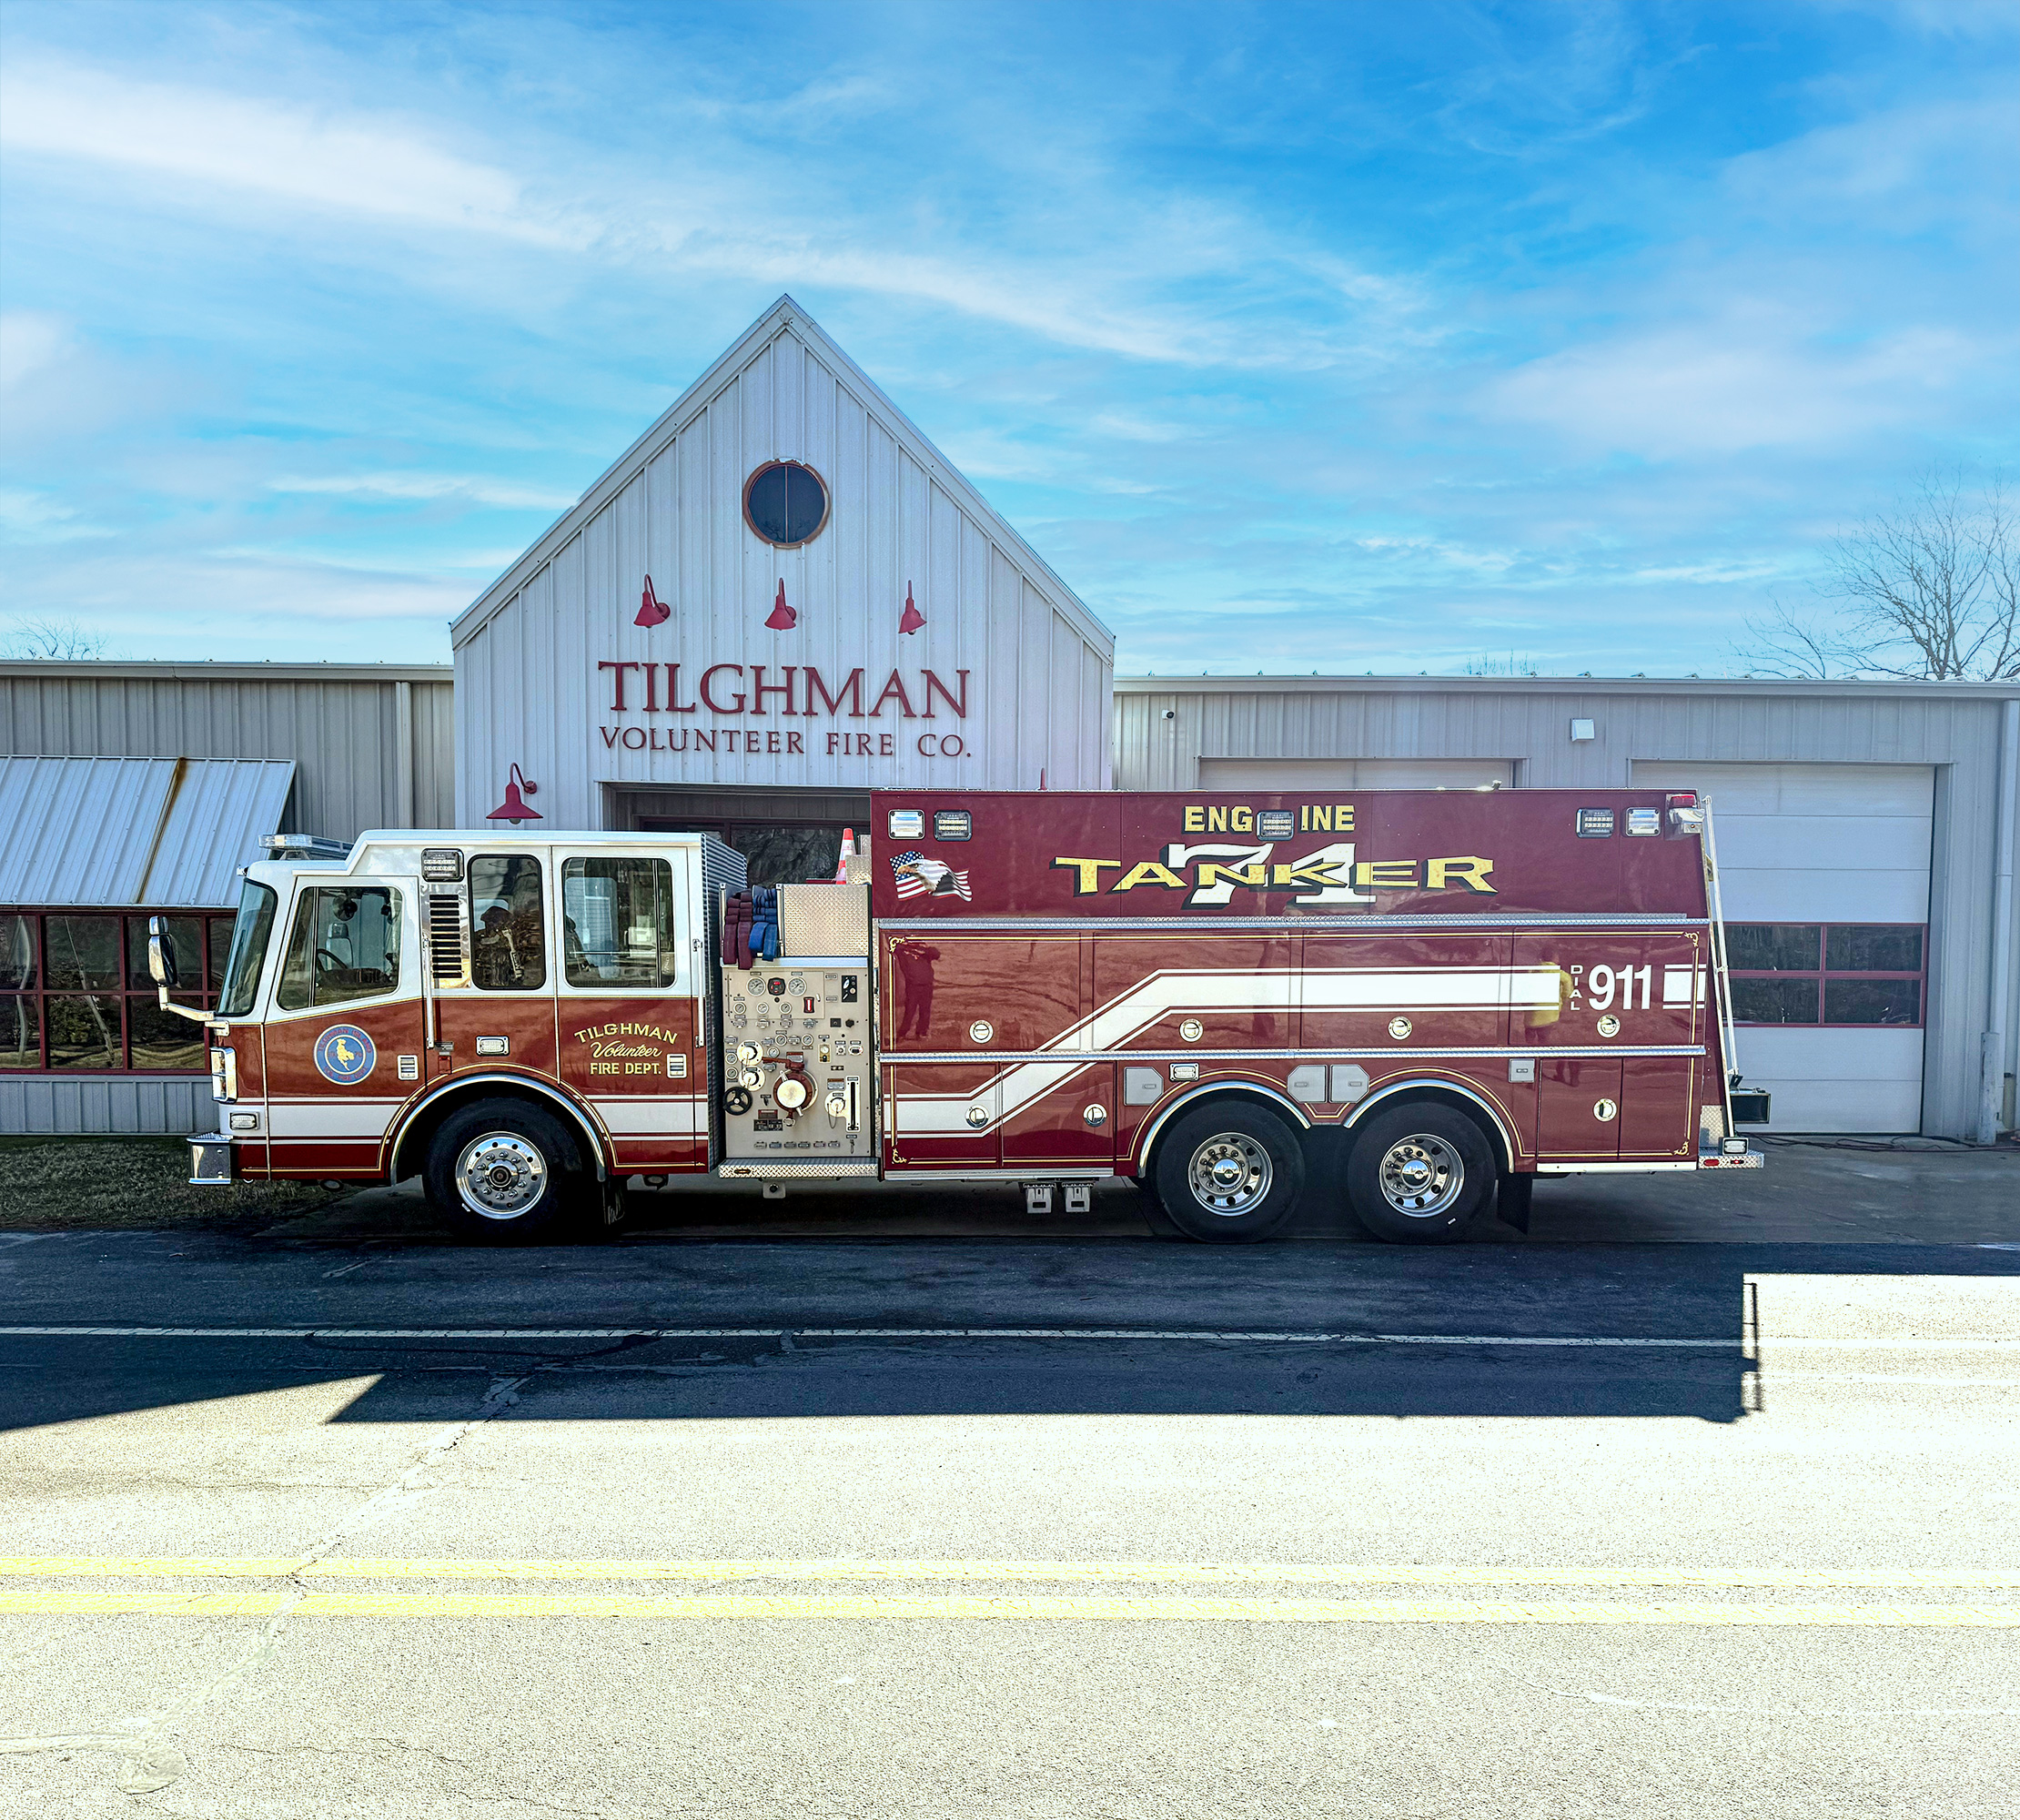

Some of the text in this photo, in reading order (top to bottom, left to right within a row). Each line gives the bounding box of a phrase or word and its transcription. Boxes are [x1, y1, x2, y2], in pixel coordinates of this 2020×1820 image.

[598, 661, 971, 719] TILGHMAN
[599, 726, 972, 758] VOLUNTEER FIRE CO.
[1053, 855, 1499, 896] TANKER
[1569, 964, 1652, 1011] DIAL 911
[573, 1022, 679, 1045] TILGHMAN
[590, 1040, 663, 1058] Volunteer
[590, 1062, 662, 1075] FIRE DEPT.
